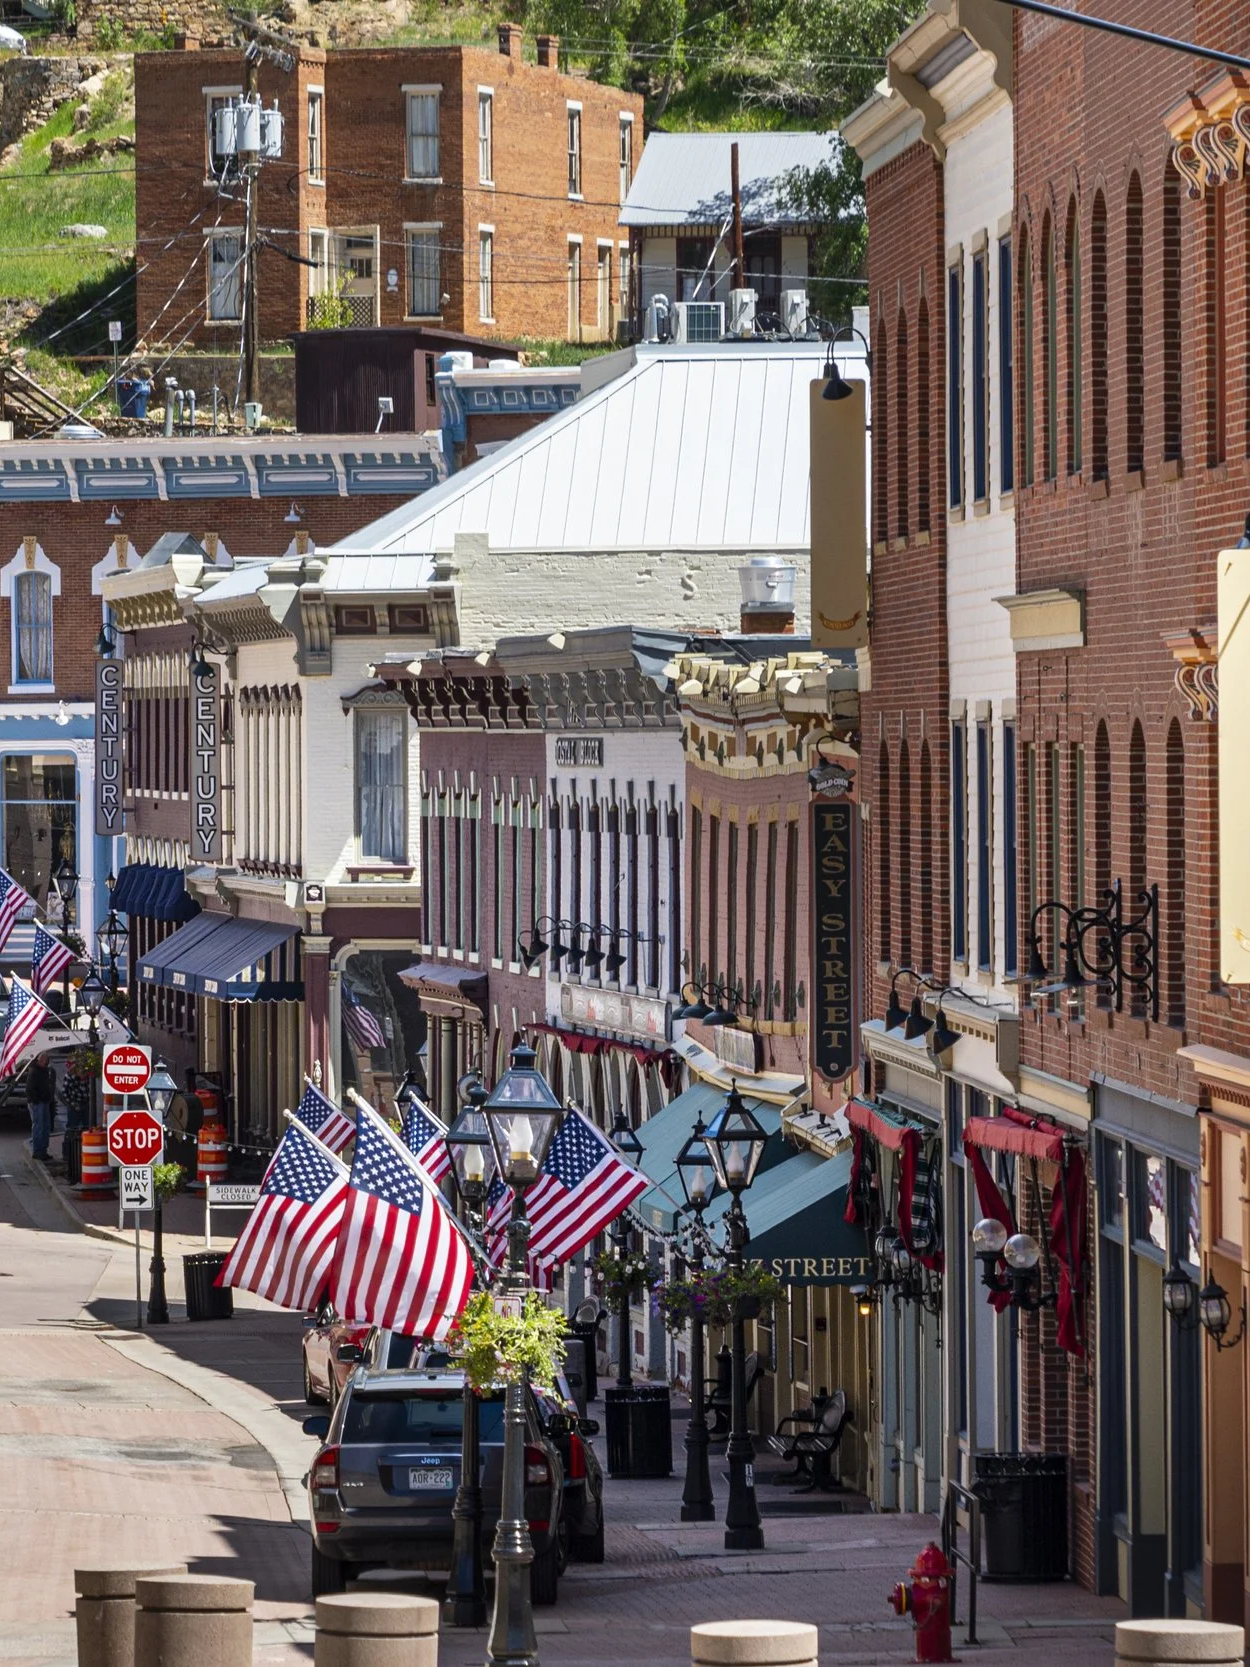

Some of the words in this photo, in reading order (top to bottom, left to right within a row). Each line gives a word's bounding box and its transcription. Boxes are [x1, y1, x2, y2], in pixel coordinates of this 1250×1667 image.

[101, 666, 118, 828] CENTURY
[195, 674, 217, 853] CENTURY
[820, 813, 848, 897] EASY
[821, 913, 850, 1048] STREET
[112, 1055, 124, 1064] DO
[126, 1055, 142, 1064] NOT
[114, 1075, 139, 1085] ENTER
[112, 1127, 159, 1149] STOP
[124, 1169, 148, 1180] ONE
[124, 1182, 149, 1193] WAY
[216, 1186, 257, 1194] SIDEWALK
[771, 1257, 870, 1277] STREET
[421, 1457, 441, 1465] Jeep
